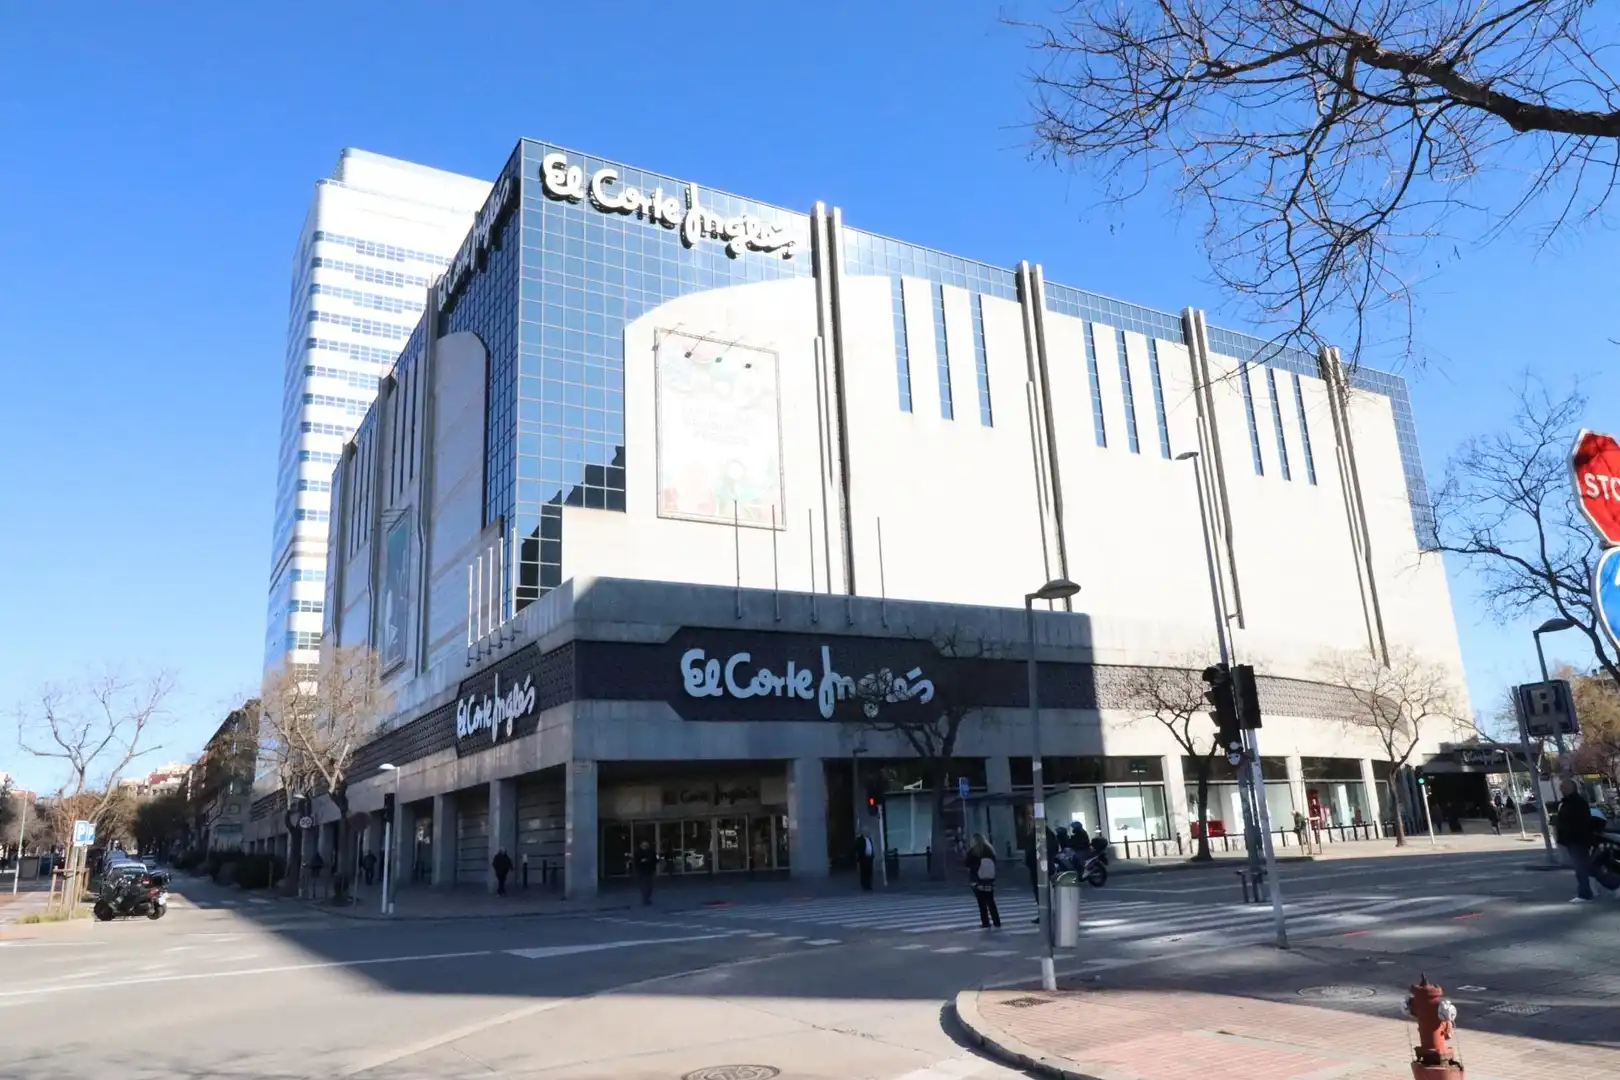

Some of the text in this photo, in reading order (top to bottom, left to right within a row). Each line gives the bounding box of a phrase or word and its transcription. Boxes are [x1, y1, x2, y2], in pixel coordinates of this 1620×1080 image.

[542, 153, 584, 201] El
[590, 169, 682, 226] Corte
[1584, 472, 1620, 502] STO
[457, 672, 535, 743] El Corte Inglés
[681, 646, 934, 719] El Corte Inglés
